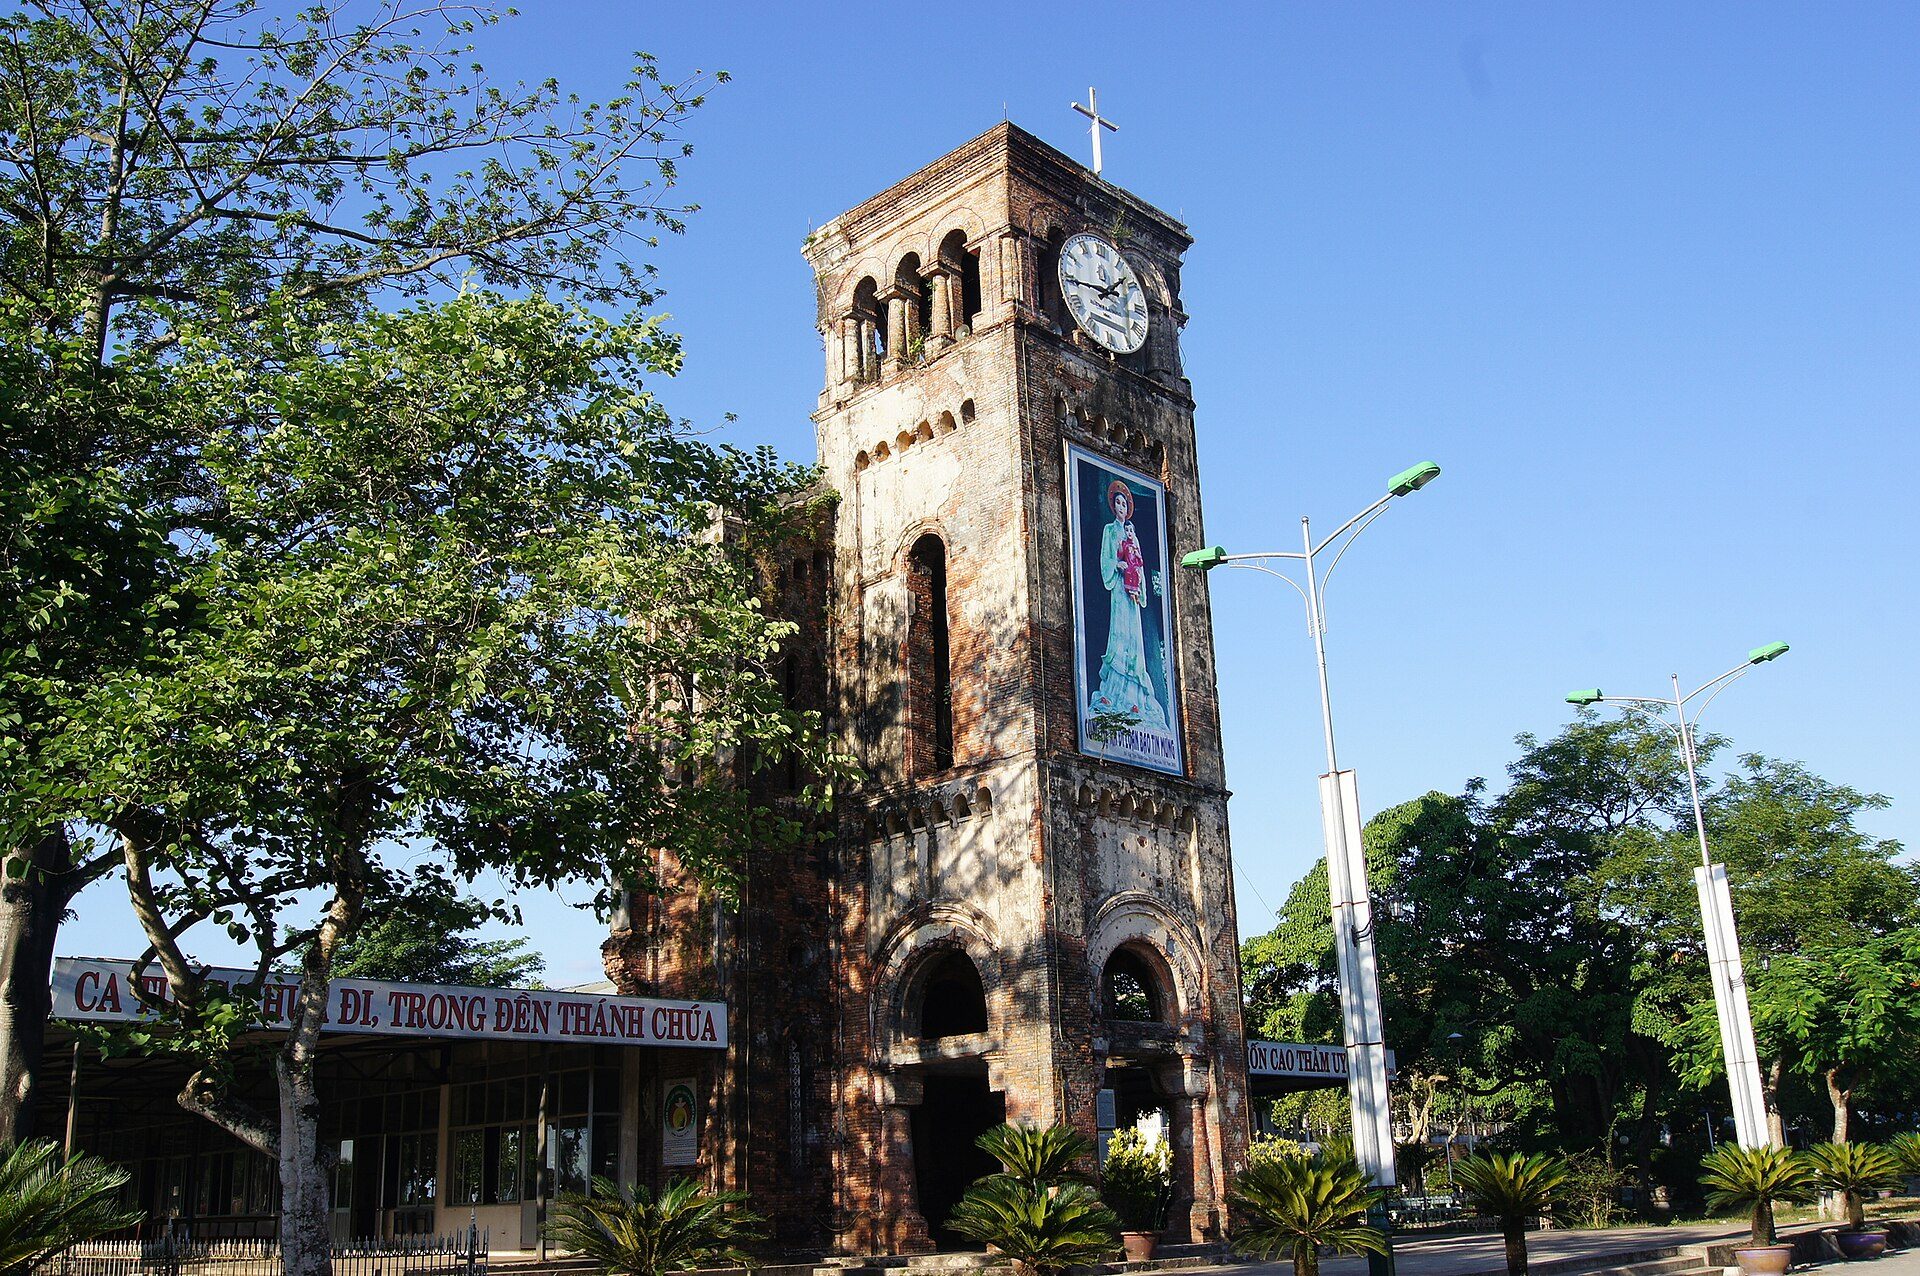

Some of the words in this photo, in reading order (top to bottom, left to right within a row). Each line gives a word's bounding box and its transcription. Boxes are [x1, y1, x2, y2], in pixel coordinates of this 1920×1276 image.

[1151, 735, 1160, 756] TIN
[75, 971, 122, 1013] CA
[337, 987, 380, 1029] ĐI,
[388, 991, 487, 1031] TRONG
[493, 992, 551, 1035] ĐỀN
[557, 998, 645, 1038] THÁNH
[652, 1004, 718, 1042] CHÚA
[1270, 1048, 1294, 1071] CAO
[1332, 1052, 1348, 1073] UY
